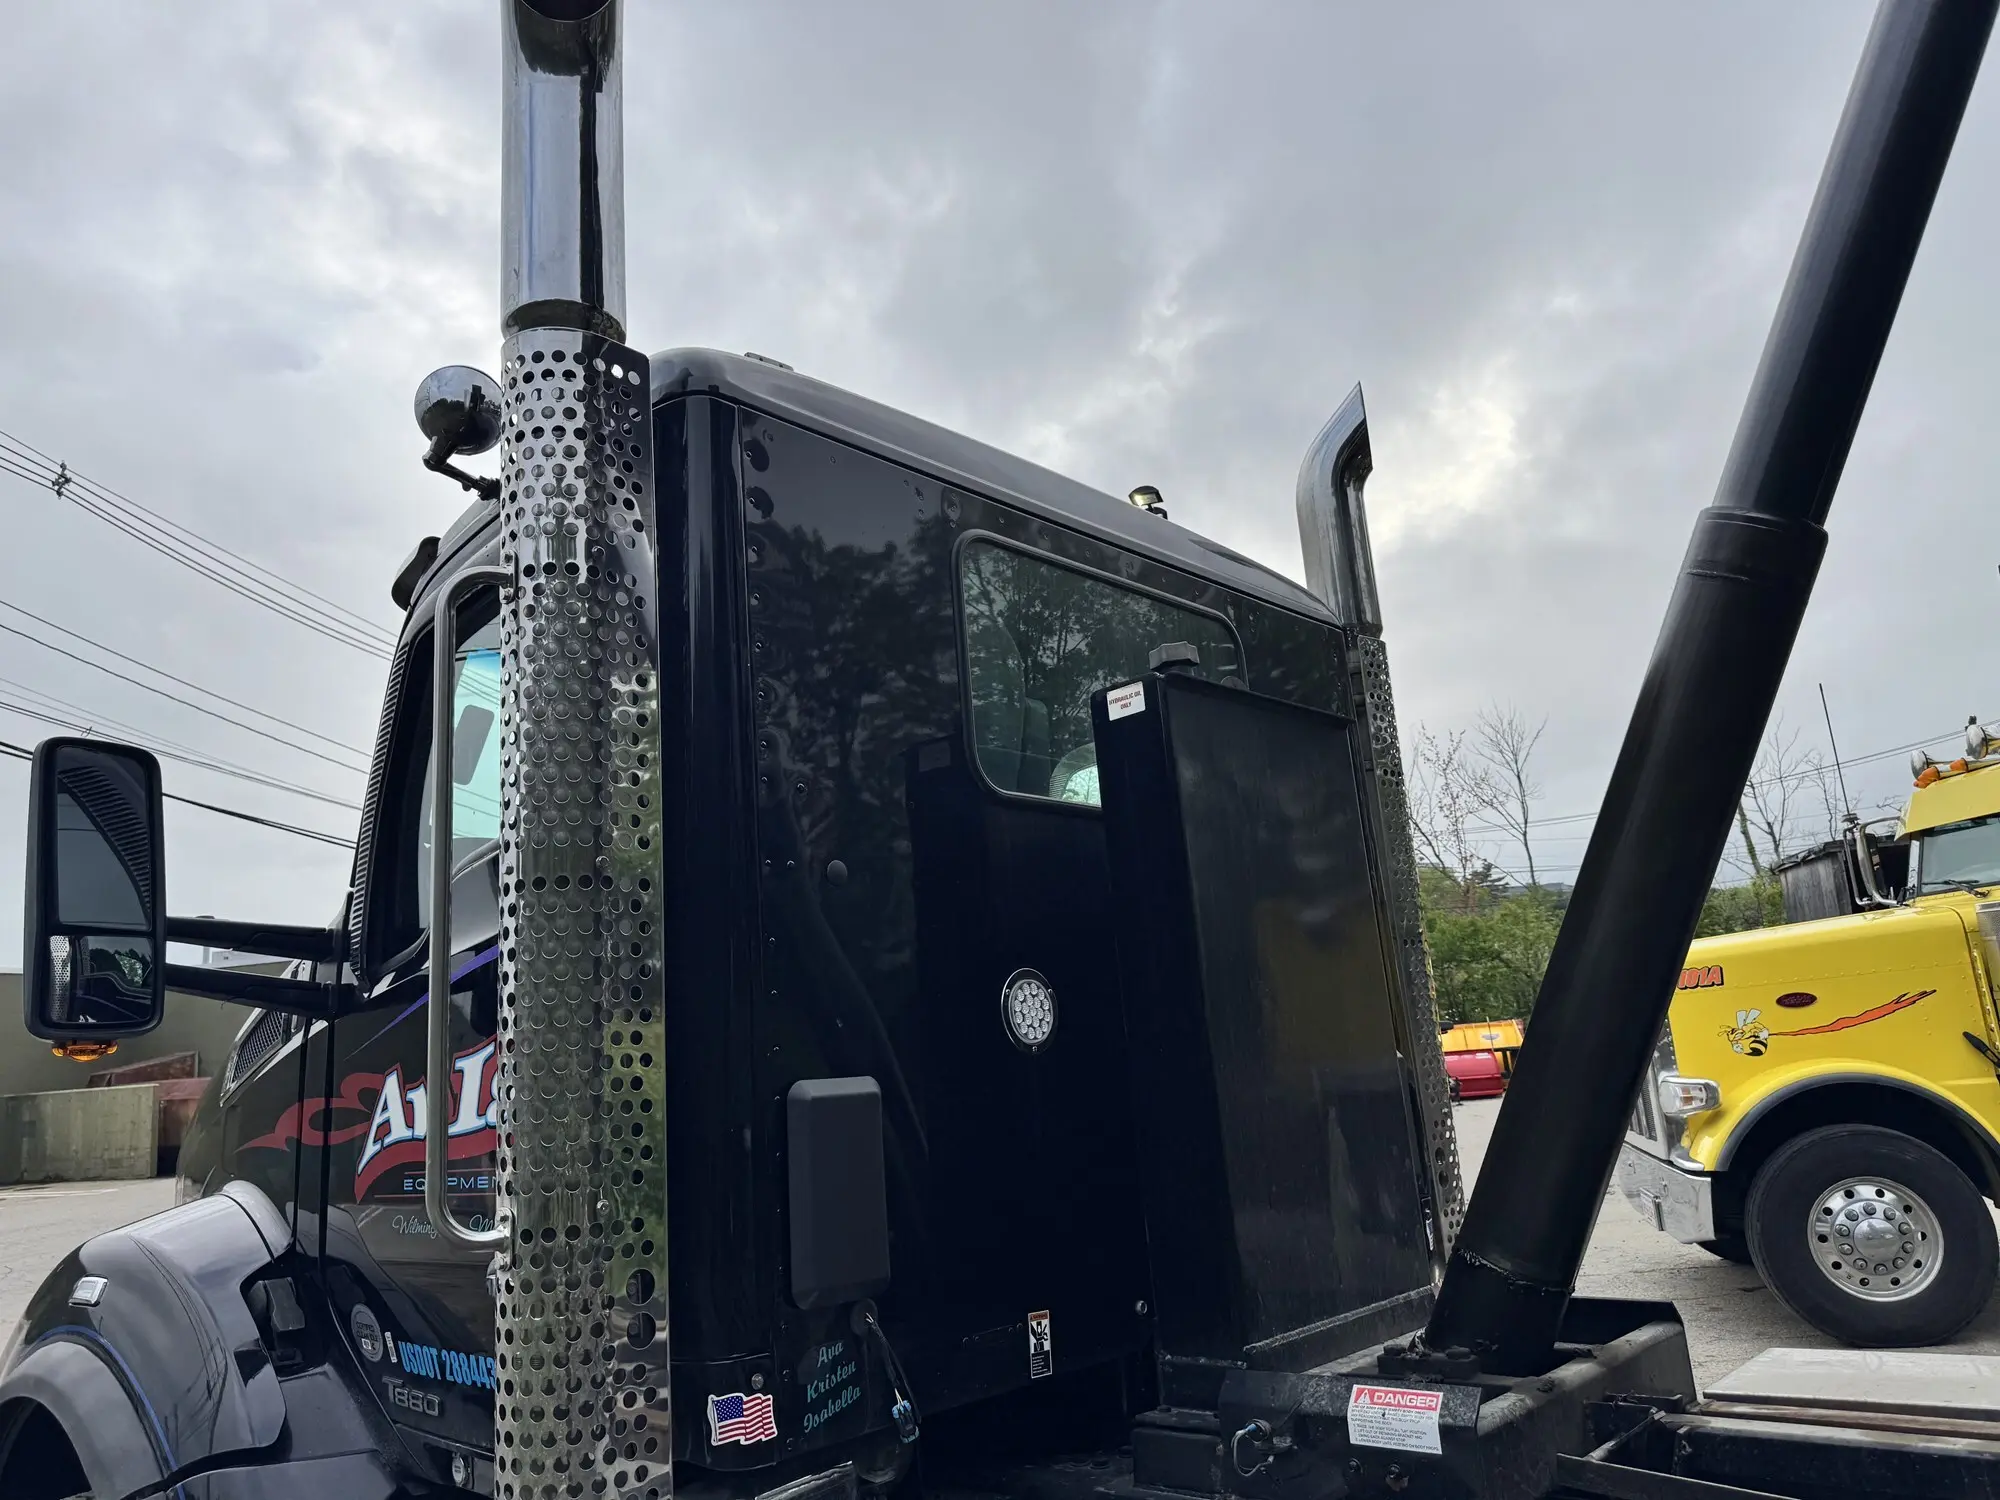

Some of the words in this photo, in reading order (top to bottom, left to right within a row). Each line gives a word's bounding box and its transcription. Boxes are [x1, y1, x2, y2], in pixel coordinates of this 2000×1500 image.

[392, 1215, 437, 1239] Wilming
[398, 1341, 441, 1380] USDOT
[817, 1342, 844, 1368] Ava
[382, 1375, 441, 1416] T880
[807, 1361, 856, 1403] Kristen
[1373, 1392, 1437, 1408] DANGER
[804, 1386, 861, 1433] Isabella
